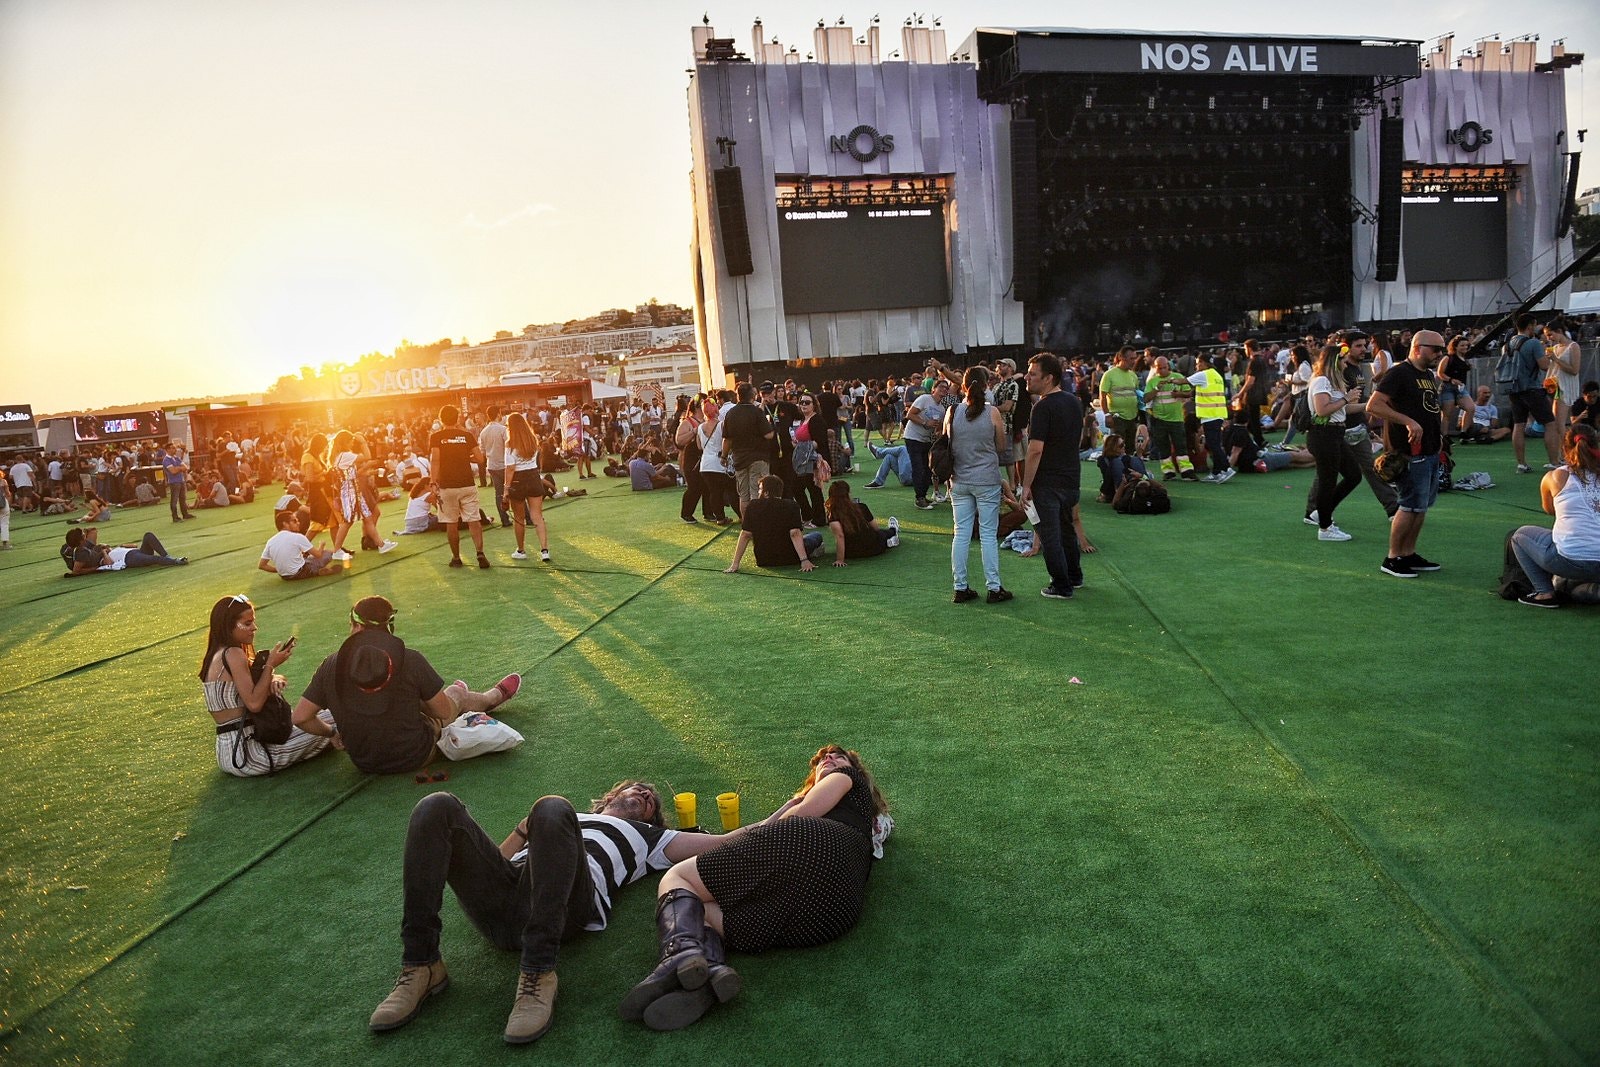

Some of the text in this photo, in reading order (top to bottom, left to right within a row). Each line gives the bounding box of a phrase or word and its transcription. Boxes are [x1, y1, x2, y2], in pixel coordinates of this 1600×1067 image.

[1140, 43, 1318, 72] NOS ALIVE
[830, 125, 895, 162] NOS
[1446, 121, 1493, 152] NOS
[368, 364, 451, 393] SAGRES
